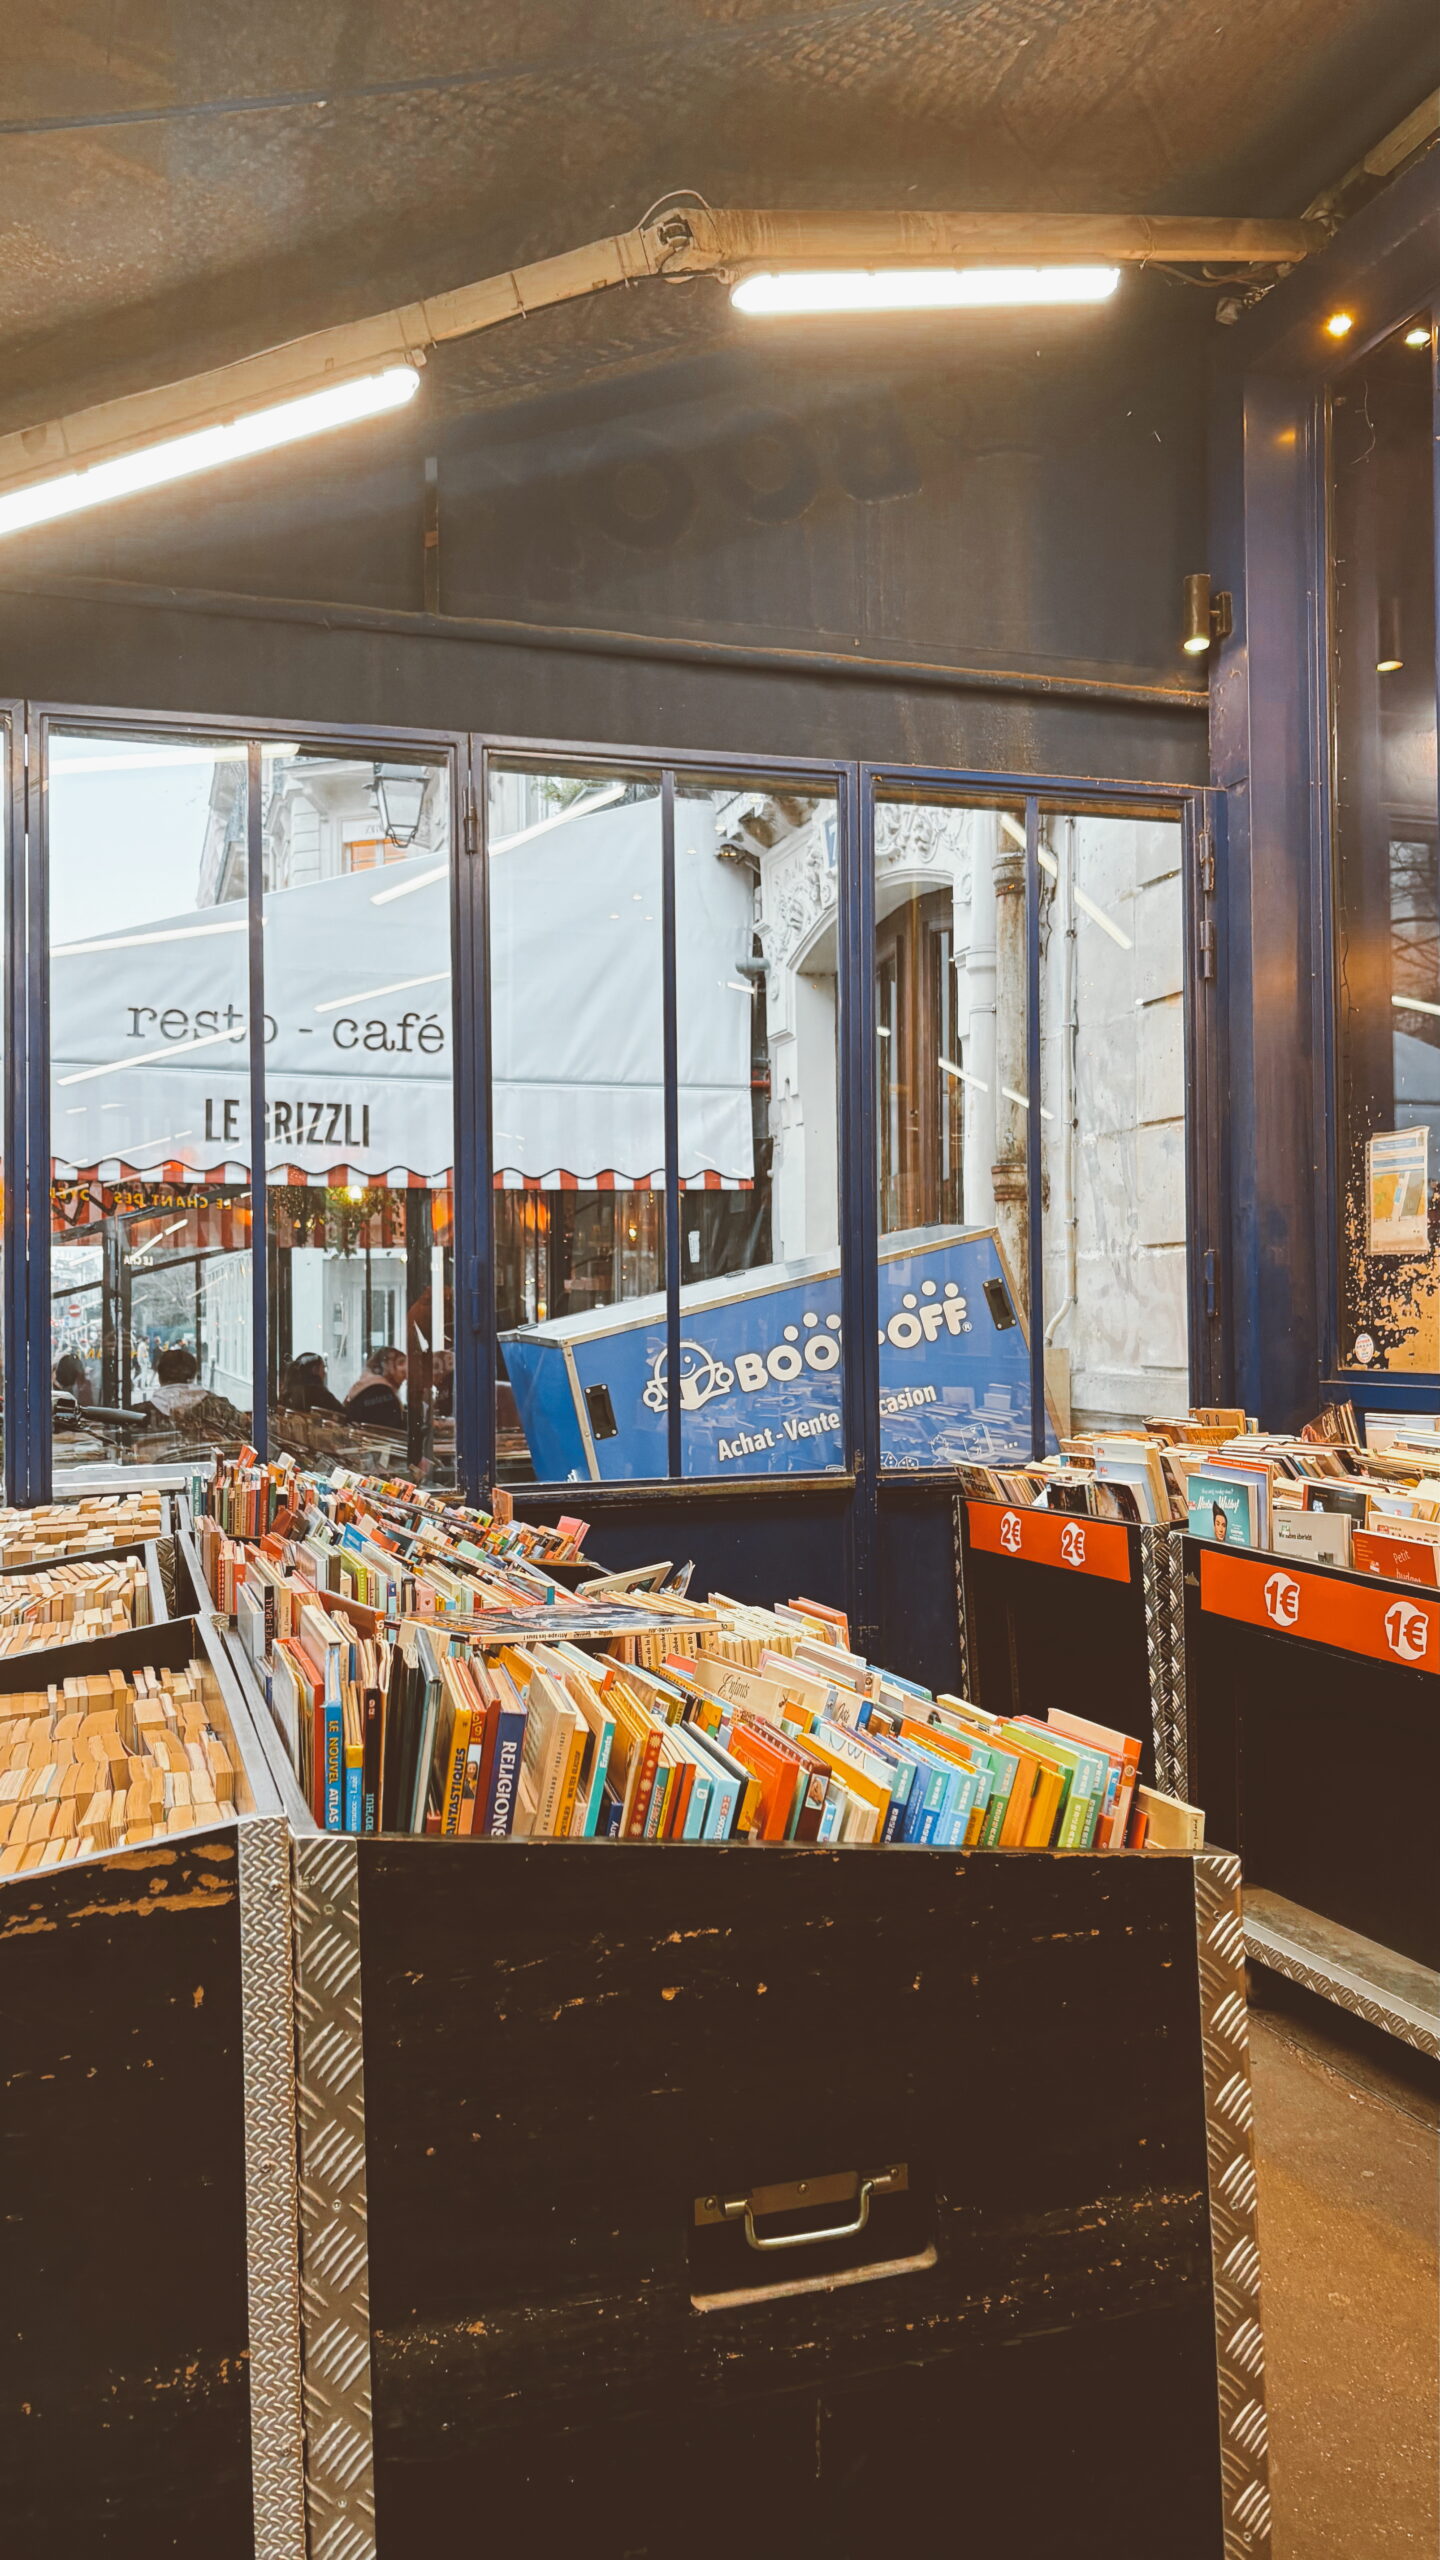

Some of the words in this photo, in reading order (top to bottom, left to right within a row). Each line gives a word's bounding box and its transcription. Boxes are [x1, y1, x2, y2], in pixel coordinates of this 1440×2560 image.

[332, 1012, 446, 1055] café
[204, 1098, 240, 1143] LE
[718, 1432, 775, 1462] Achat
[784, 1411, 840, 1443] Vente
[879, 1384, 938, 1417] casion
[1000, 1514, 1022, 1549] 2€
[1061, 1526, 1085, 1562] 2€
[1264, 1579, 1300, 1622] 1€
[1384, 1609, 1426, 1654] 1€
[328, 1720, 339, 1733] LE
[327, 1737, 339, 1785] NOUVEL
[328, 1788, 339, 1824] ATLAS
[446, 1747, 466, 1836] ANTASTIQUES
[490, 1740, 518, 1837] RELIGIONS
[365, 1793, 375, 1832] RD'HUI
[609, 1820, 619, 1838] any
